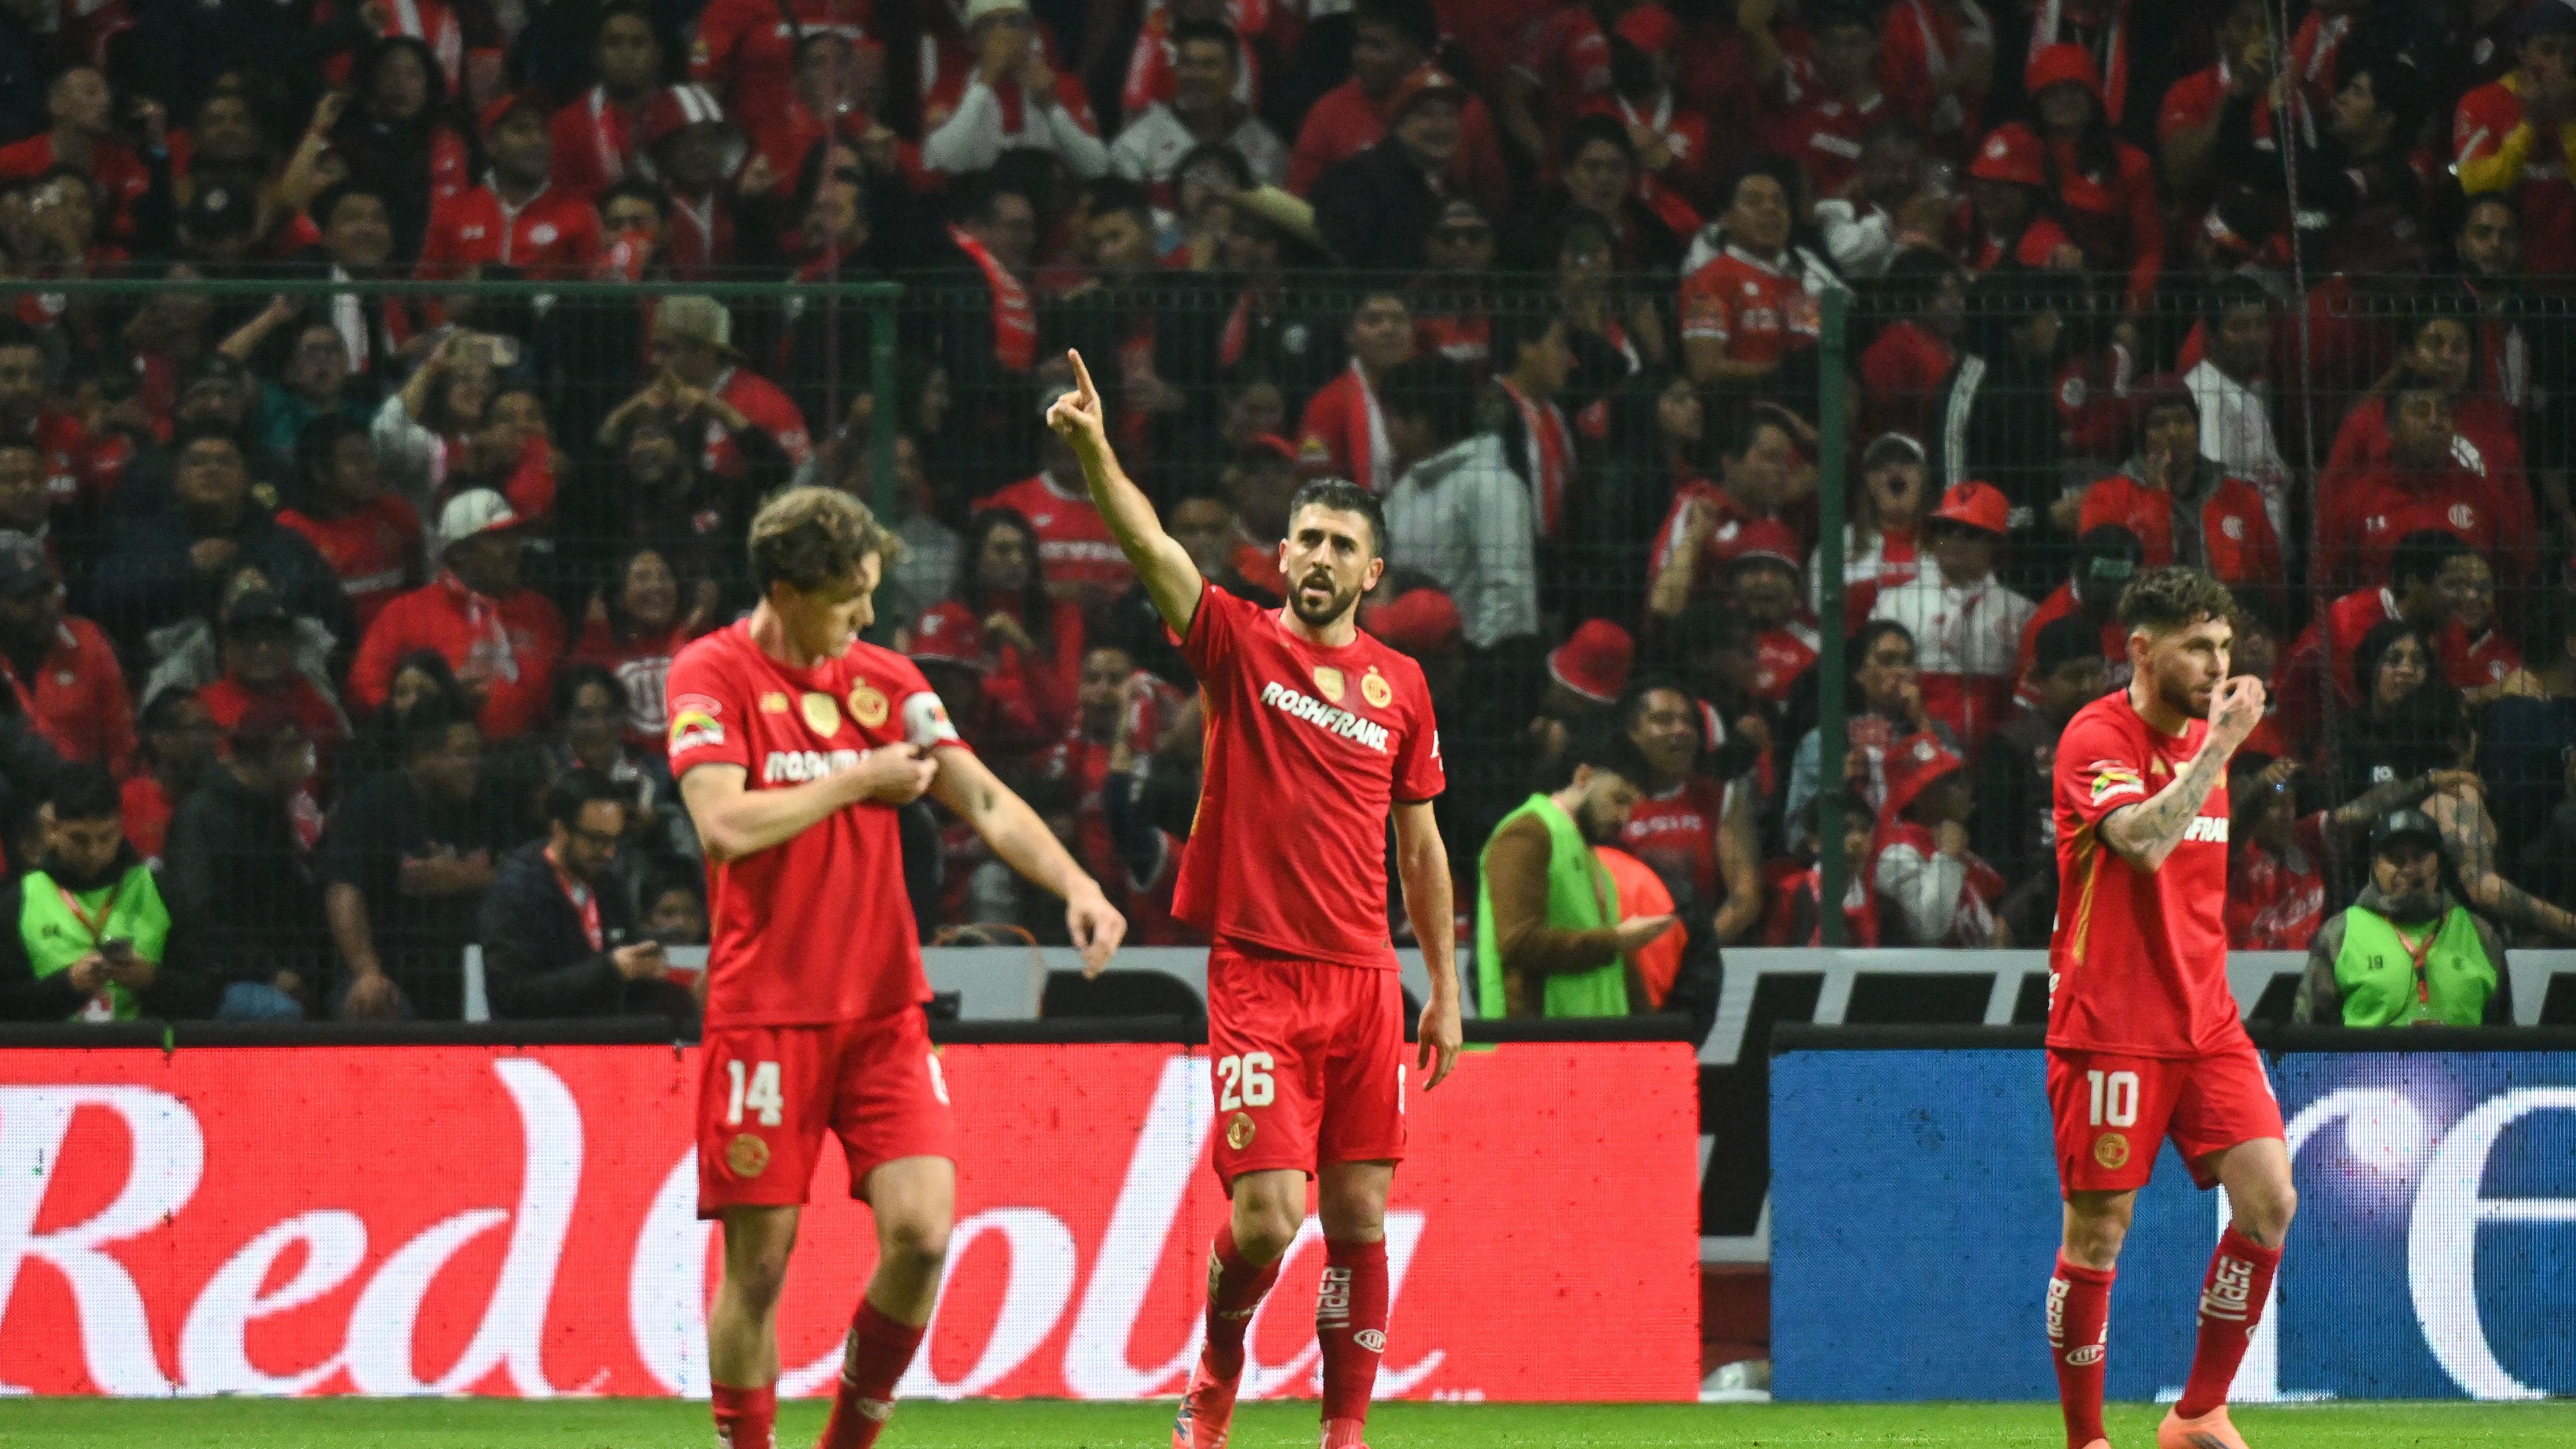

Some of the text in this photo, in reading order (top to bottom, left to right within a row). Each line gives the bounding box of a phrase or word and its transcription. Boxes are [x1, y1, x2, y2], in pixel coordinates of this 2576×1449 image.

[1261, 680, 1389, 754] ROSHFRANS
[727, 1059, 784, 1127] 14
[1217, 1052, 1275, 1112] 26
[2087, 1070, 2139, 1127] 10
[0, 1058, 611, 1399] Red
